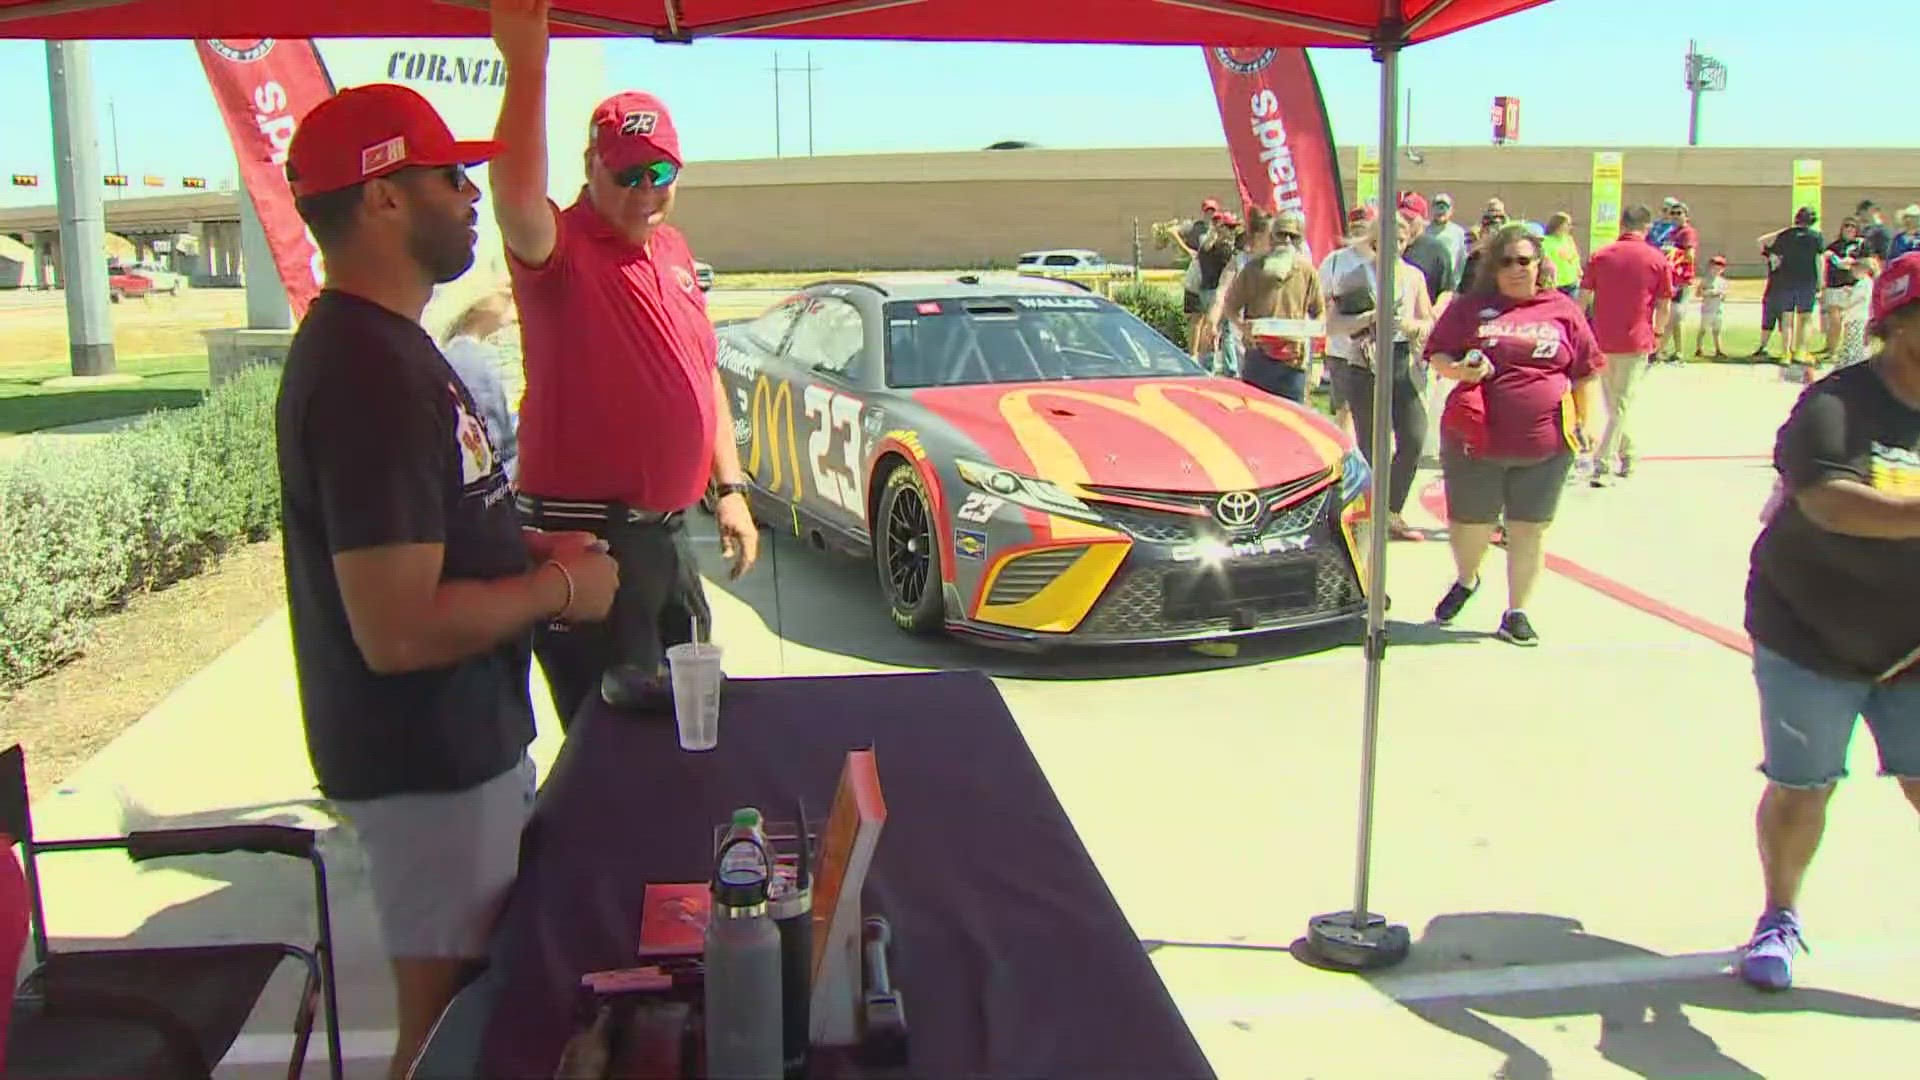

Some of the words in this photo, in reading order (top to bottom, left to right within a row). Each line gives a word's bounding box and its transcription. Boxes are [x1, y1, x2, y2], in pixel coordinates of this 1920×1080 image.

[621, 112, 657, 136] 23
[804, 384, 865, 520] 23
[957, 491, 1006, 524] 23
